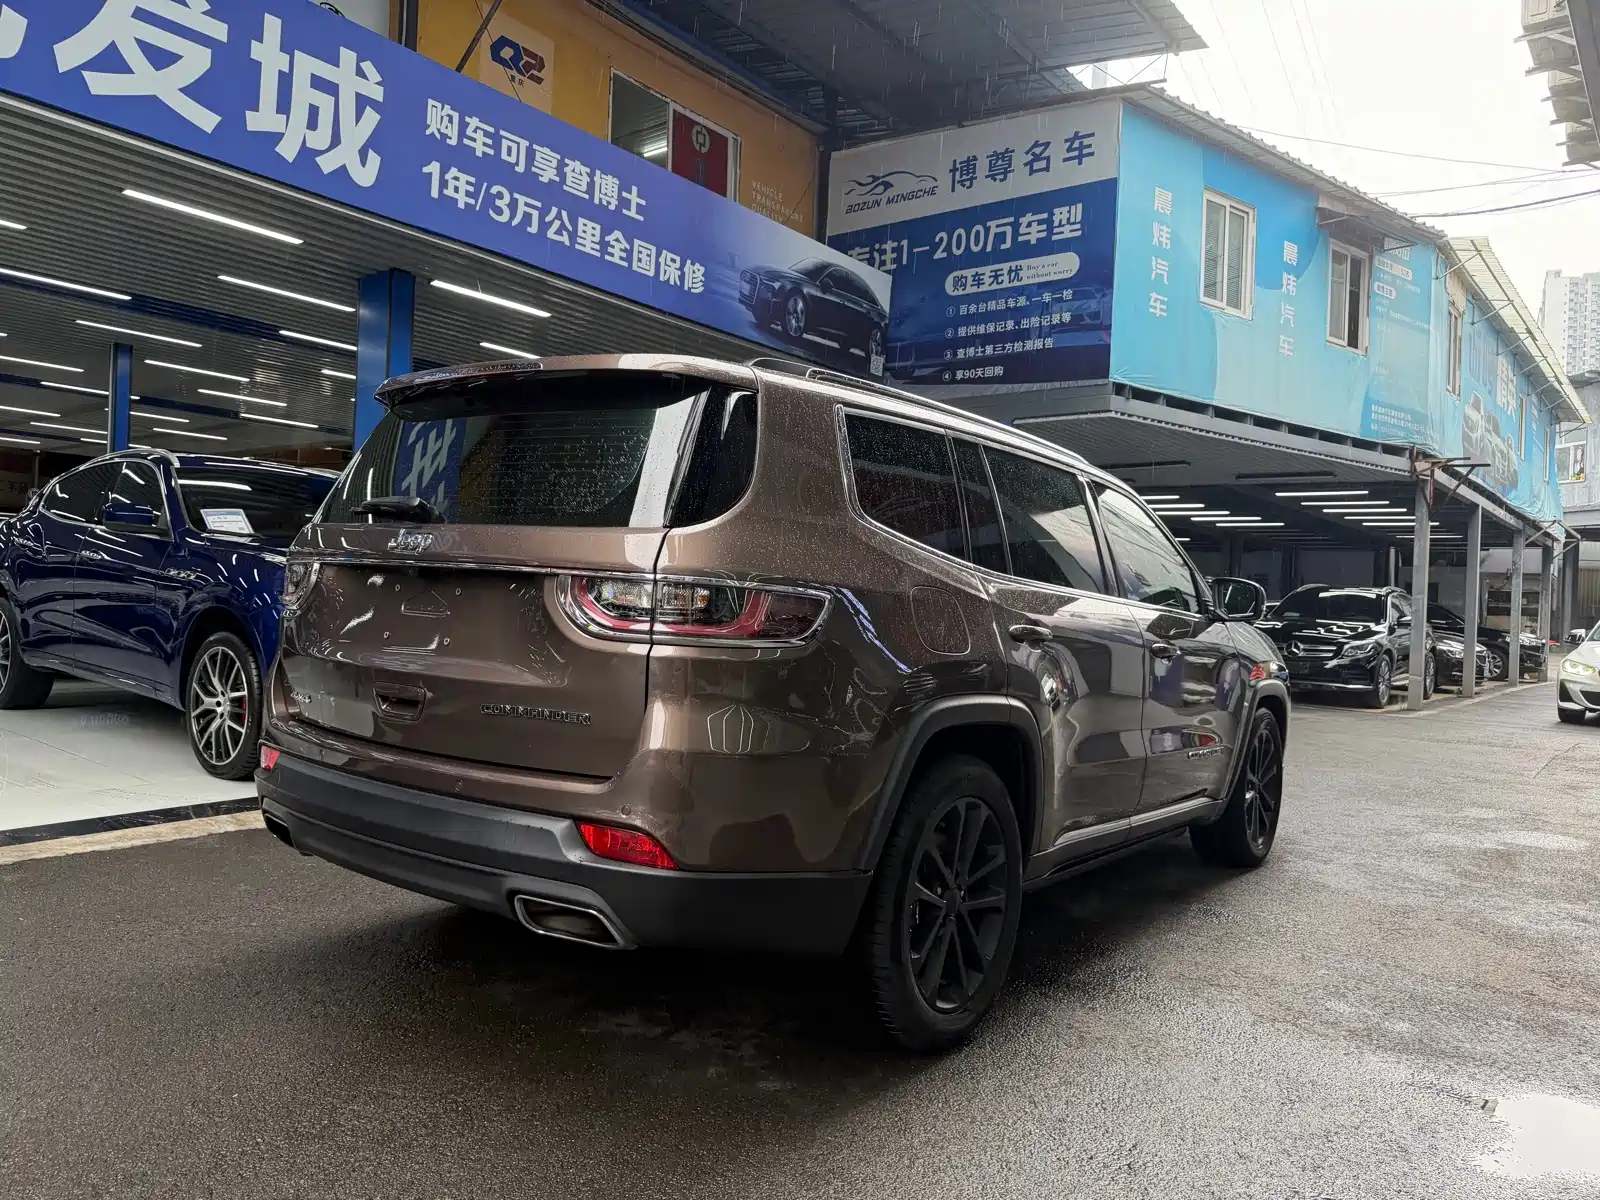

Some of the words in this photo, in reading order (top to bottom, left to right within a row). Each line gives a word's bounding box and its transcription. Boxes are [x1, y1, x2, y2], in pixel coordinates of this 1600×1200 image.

[0, 0, 384, 187] 发城
[425, 98, 646, 221] 购车可享查博士
[845, 198, 882, 214] BOZUN
[886, 186, 938, 206] MINGCHE
[949, 131, 1095, 192] 博尊名车
[422, 161, 706, 294] 1年/3万公里全国保修
[1149, 187, 1172, 317] 晨炜汽车
[952, 264, 1023, 292] 购车无忧
[1279, 240, 1298, 357] 晨炜汽车
[387, 528, 434, 556] Jeep
[480, 703, 591, 724] COMMANDER
